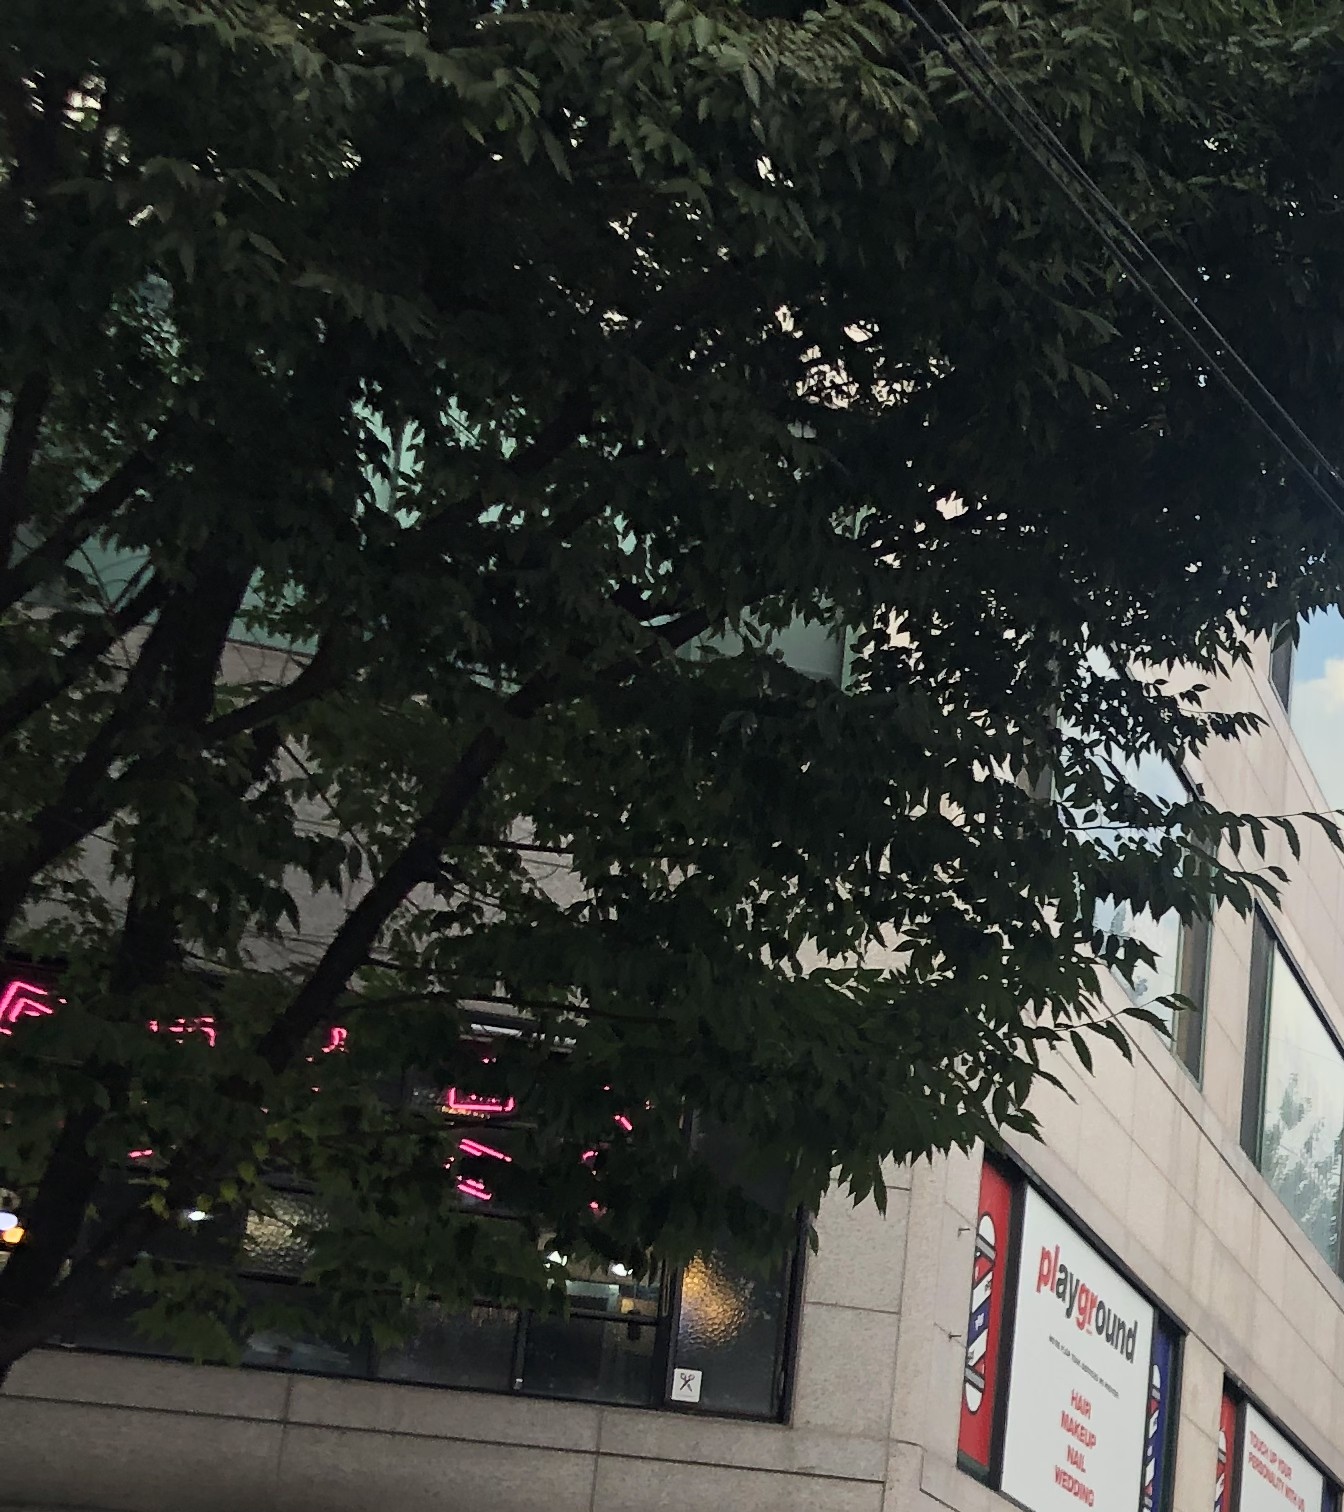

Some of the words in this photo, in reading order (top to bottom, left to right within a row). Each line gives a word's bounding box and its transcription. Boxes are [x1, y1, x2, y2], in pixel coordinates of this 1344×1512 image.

[1036, 1244, 1139, 1364] playground
[1070, 1388, 1092, 1420] HAIR
[1060, 1409, 1097, 1450] MAKEUP
[1066, 1444, 1086, 1474] NAIL
[1054, 1464, 1095, 1508] WEDDING
